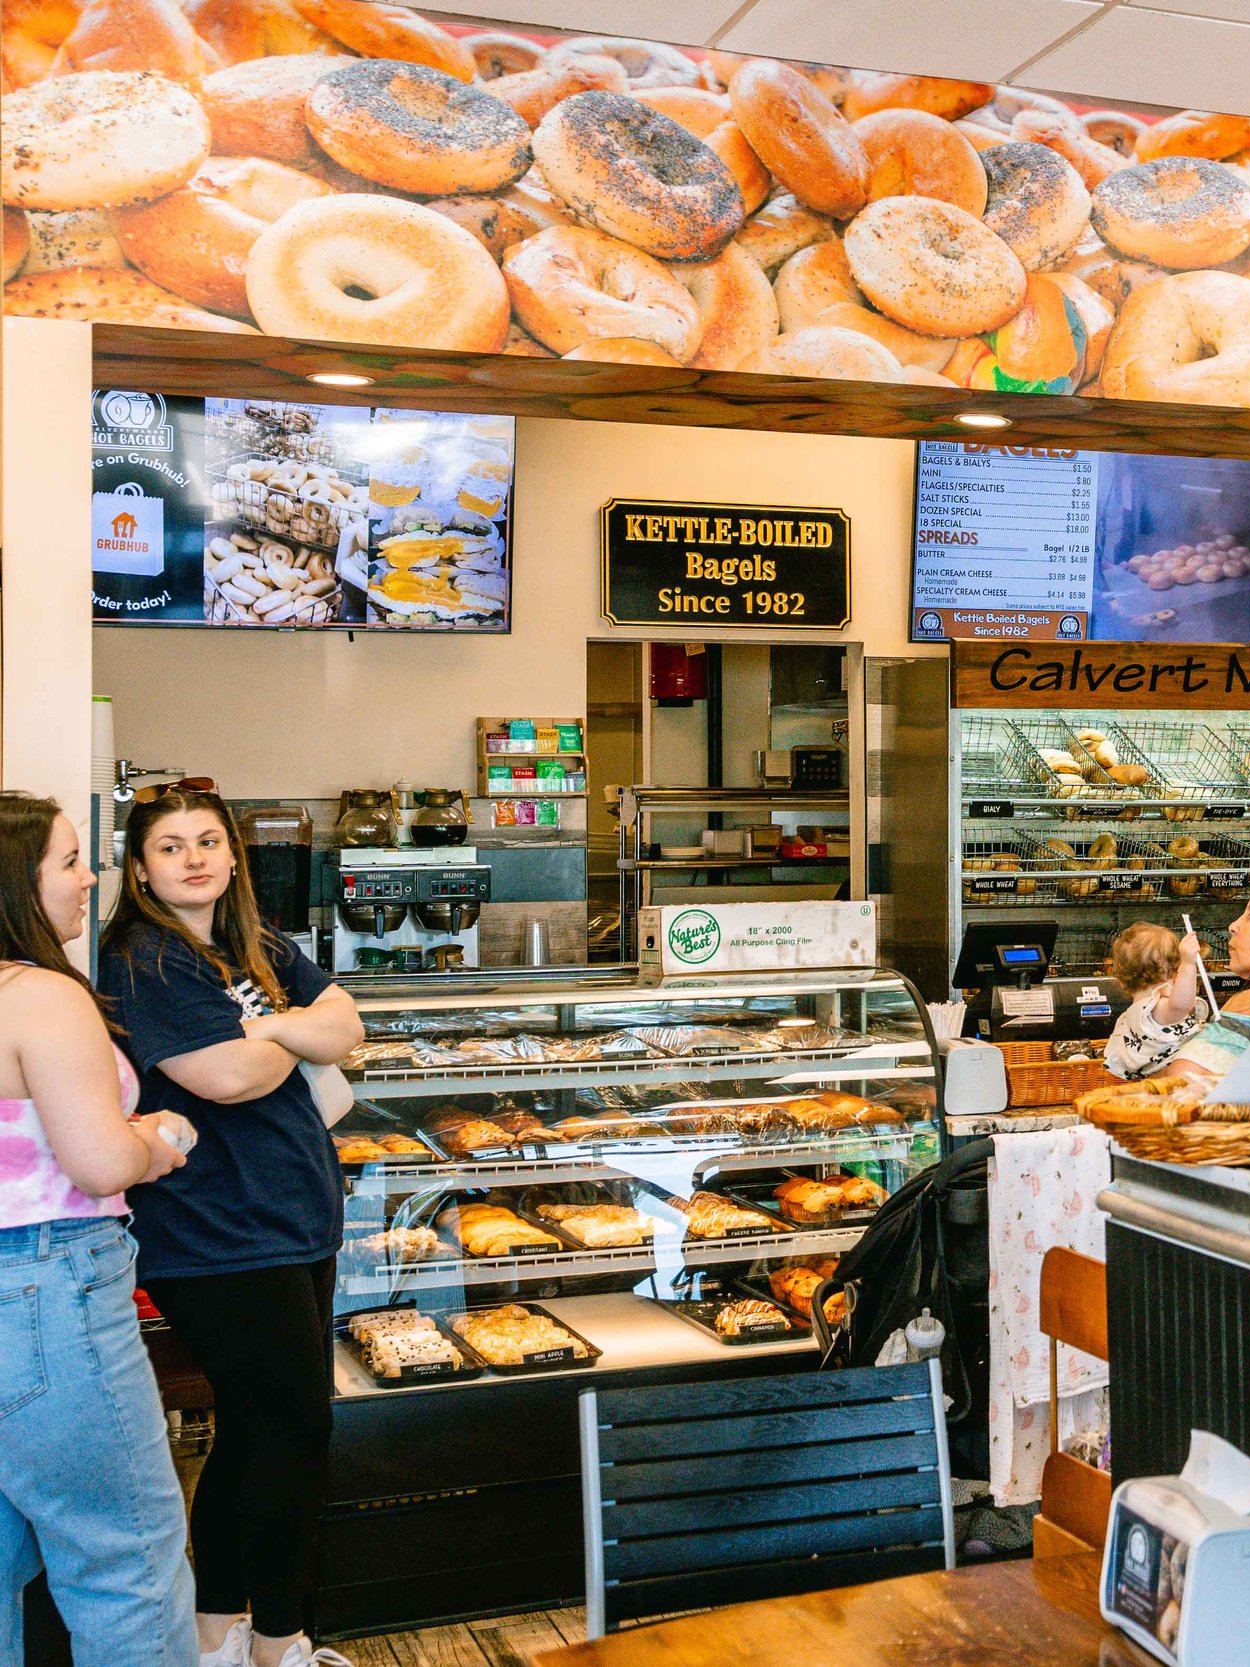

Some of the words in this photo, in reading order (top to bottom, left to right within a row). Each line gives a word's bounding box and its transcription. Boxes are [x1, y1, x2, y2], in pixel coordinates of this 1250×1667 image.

[92, 433, 114, 444] HOT
[120, 433, 165, 446] BAGELS
[922, 456, 953, 466] BAGELS
[954, 457, 961, 466] &
[963, 458, 991, 468] BIALYS
[106, 455, 124, 465] on
[127, 453, 191, 488] Grubhub!
[921, 469, 942, 477] MINI
[1072, 464, 1092, 473] $1.50
[921, 481, 1005, 493] FLAGELS/SPECIALTIES
[1071, 488, 1091, 498] $2.25
[920, 494, 940, 503] SALT
[941, 495, 970, 504] STICKS
[1071, 500, 1091, 510] $1.55
[920, 506, 949, 515] DOZEN
[950, 507, 983, 517] SPECIAL
[1066, 513, 1090, 522] $13.00
[920, 518, 929, 527] 18
[931, 519, 963, 528] SPECIAL
[625, 514, 833, 549] KETTLE-BOILED
[1066, 525, 1090, 534] $18.00
[918, 529, 979, 546] SPREADS
[96, 538, 149, 553] GRUBHUB
[1043, 544, 1065, 553] Bagel
[1068, 545, 1080, 553] 1/2
[1081, 545, 1090, 553] LB
[917, 550, 946, 558] BUTTER
[685, 551, 777, 586] Bagels
[917, 568, 939, 577] PLAIN
[940, 569, 967, 578] CREAM
[967, 570, 993, 579] CHEESE
[924, 577, 958, 586] Homemade
[916, 586, 953, 595] SPECIALTY
[954, 588, 981, 596] CREAM
[982, 588, 1008, 597] CHEESE
[125, 590, 172, 611] today!
[658, 587, 731, 613] Since
[742, 590, 805, 616] 1982
[923, 596, 958, 604] Homemade
[953, 612, 985, 623] Kettle
[986, 613, 1016, 624] Boiled
[1018, 614, 1050, 626] Bagels
[974, 626, 1001, 636] Since
[1001, 626, 1029, 636] 1982
[989, 648, 1210, 694] Calvert
[983, 805, 1001, 813] BIALY
[366, 873, 390, 881] BUNN
[1122, 874, 1140, 882] WHEAT
[975, 881, 994, 889] WHOLE
[996, 880, 1016, 889] WHEAT
[1109, 881, 1132, 889] SESAME
[1211, 879, 1244, 887] EVERYTHING
[671, 919, 718, 946] Nature's
[772, 926, 793, 935] 2000
[681, 935, 713, 954] Best
[730, 939, 741, 947] All
[741, 938, 774, 948] Purpose
[775, 938, 796, 947] Cling
[796, 937, 813, 945] Film
[1221, 979, 1241, 987] ONION
[521, 1246, 549, 1255] CROISSANT
[750, 1324, 775, 1332] CINNAMON
[534, 1353, 546, 1361] MINI
[547, 1350, 565, 1359] APPLE
[413, 1363, 442, 1372] CHOCOLATE
